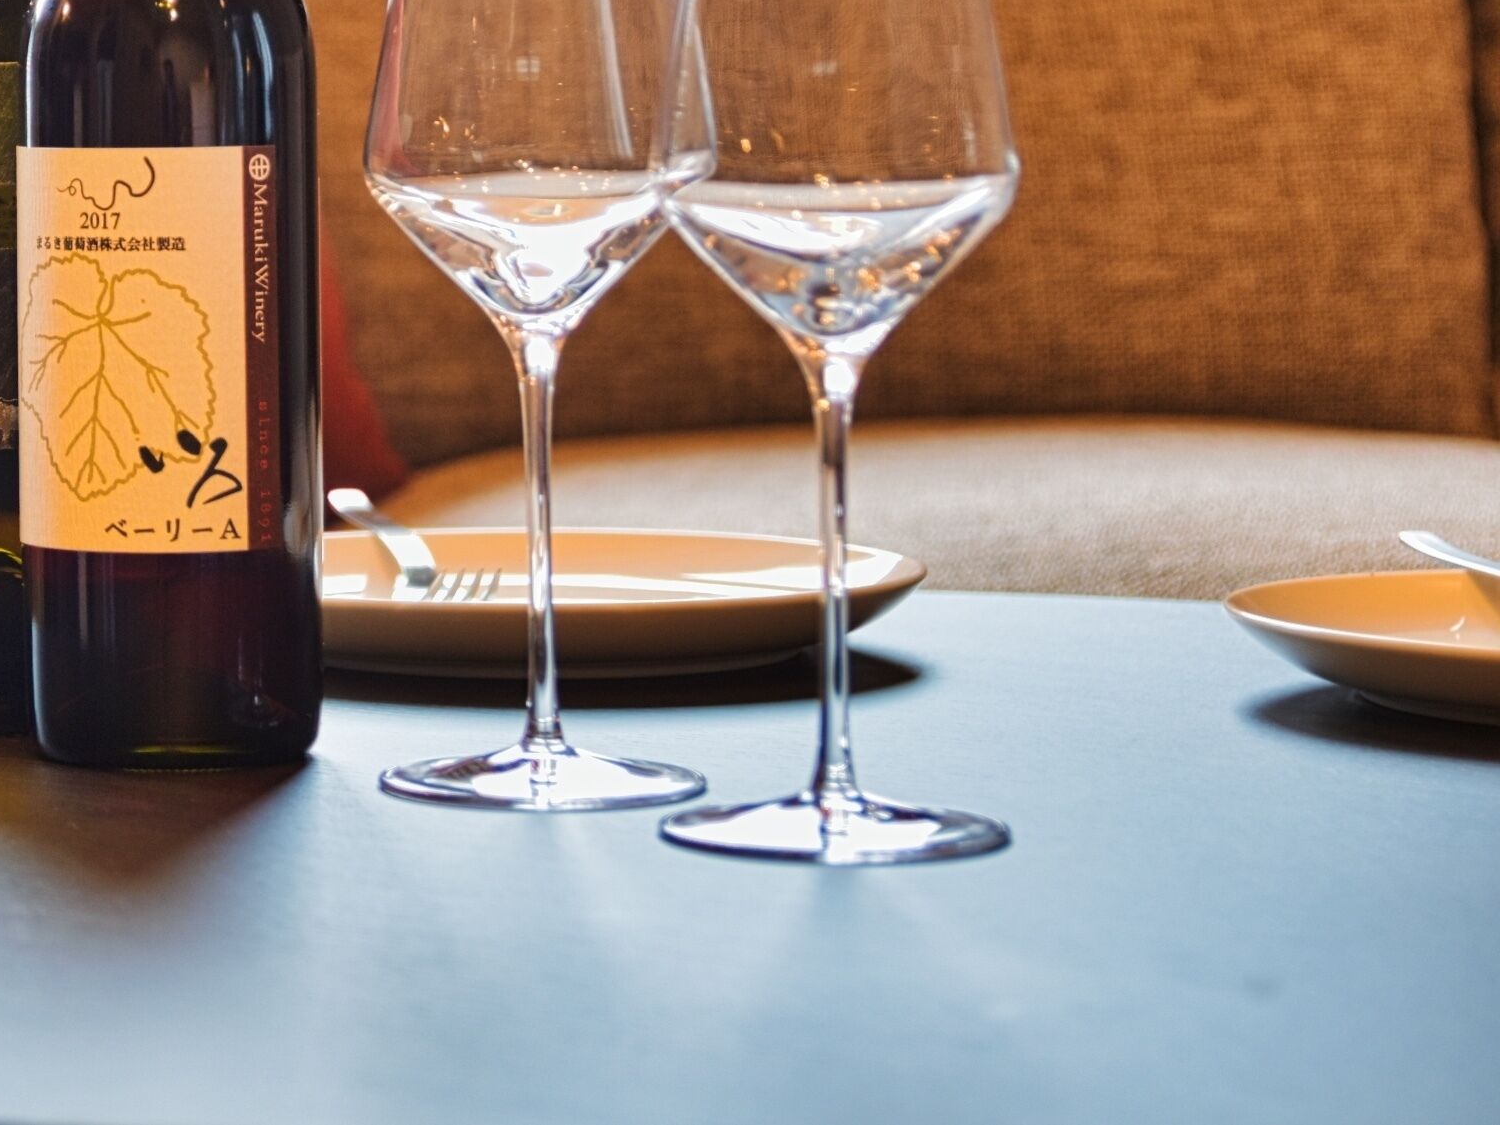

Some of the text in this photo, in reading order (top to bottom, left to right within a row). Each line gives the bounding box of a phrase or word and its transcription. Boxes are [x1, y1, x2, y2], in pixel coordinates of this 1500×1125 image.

[80, 212, 121, 230] 2017
[36, 236, 186, 251] まるき葡萄酒株式会社製造
[104, 518, 242, 542] ベーリーA
